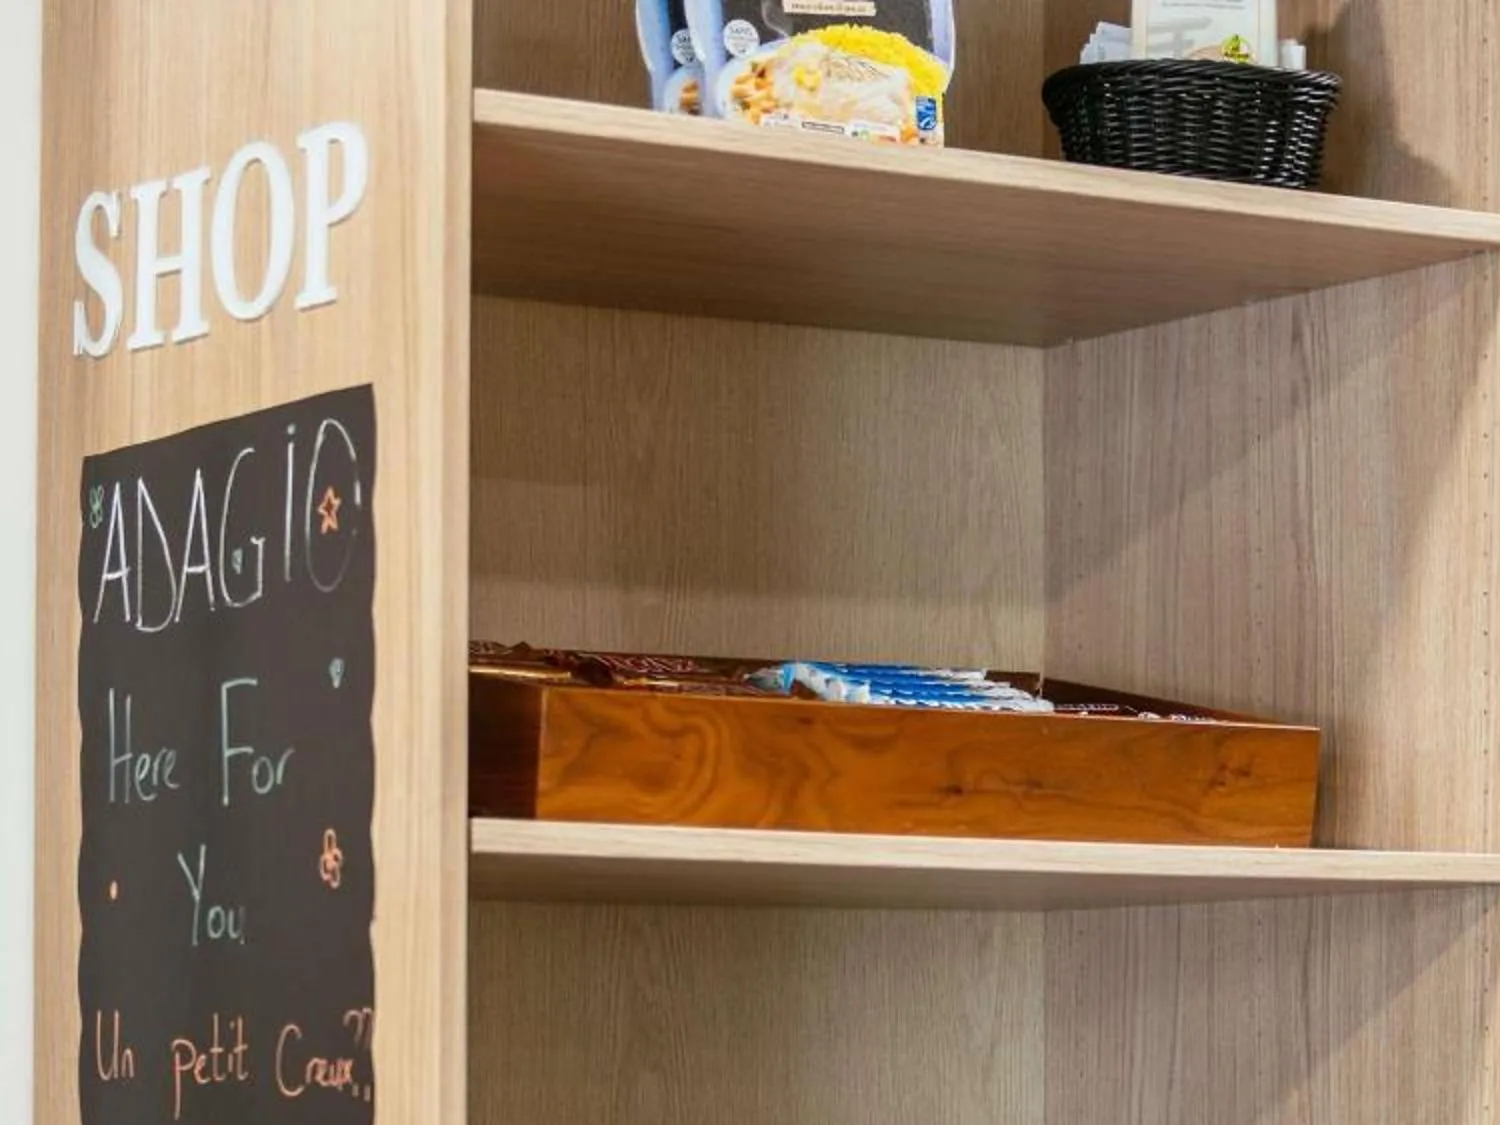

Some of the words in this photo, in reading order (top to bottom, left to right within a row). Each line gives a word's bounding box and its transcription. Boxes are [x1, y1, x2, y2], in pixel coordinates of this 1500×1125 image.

[73, 121, 370, 358] SHOP
[108, 687, 181, 803] Here
[221, 677, 295, 806] For
[177, 843, 247, 947] You
[96, 1010, 136, 1081] Un
[171, 1012, 249, 1121] petit
